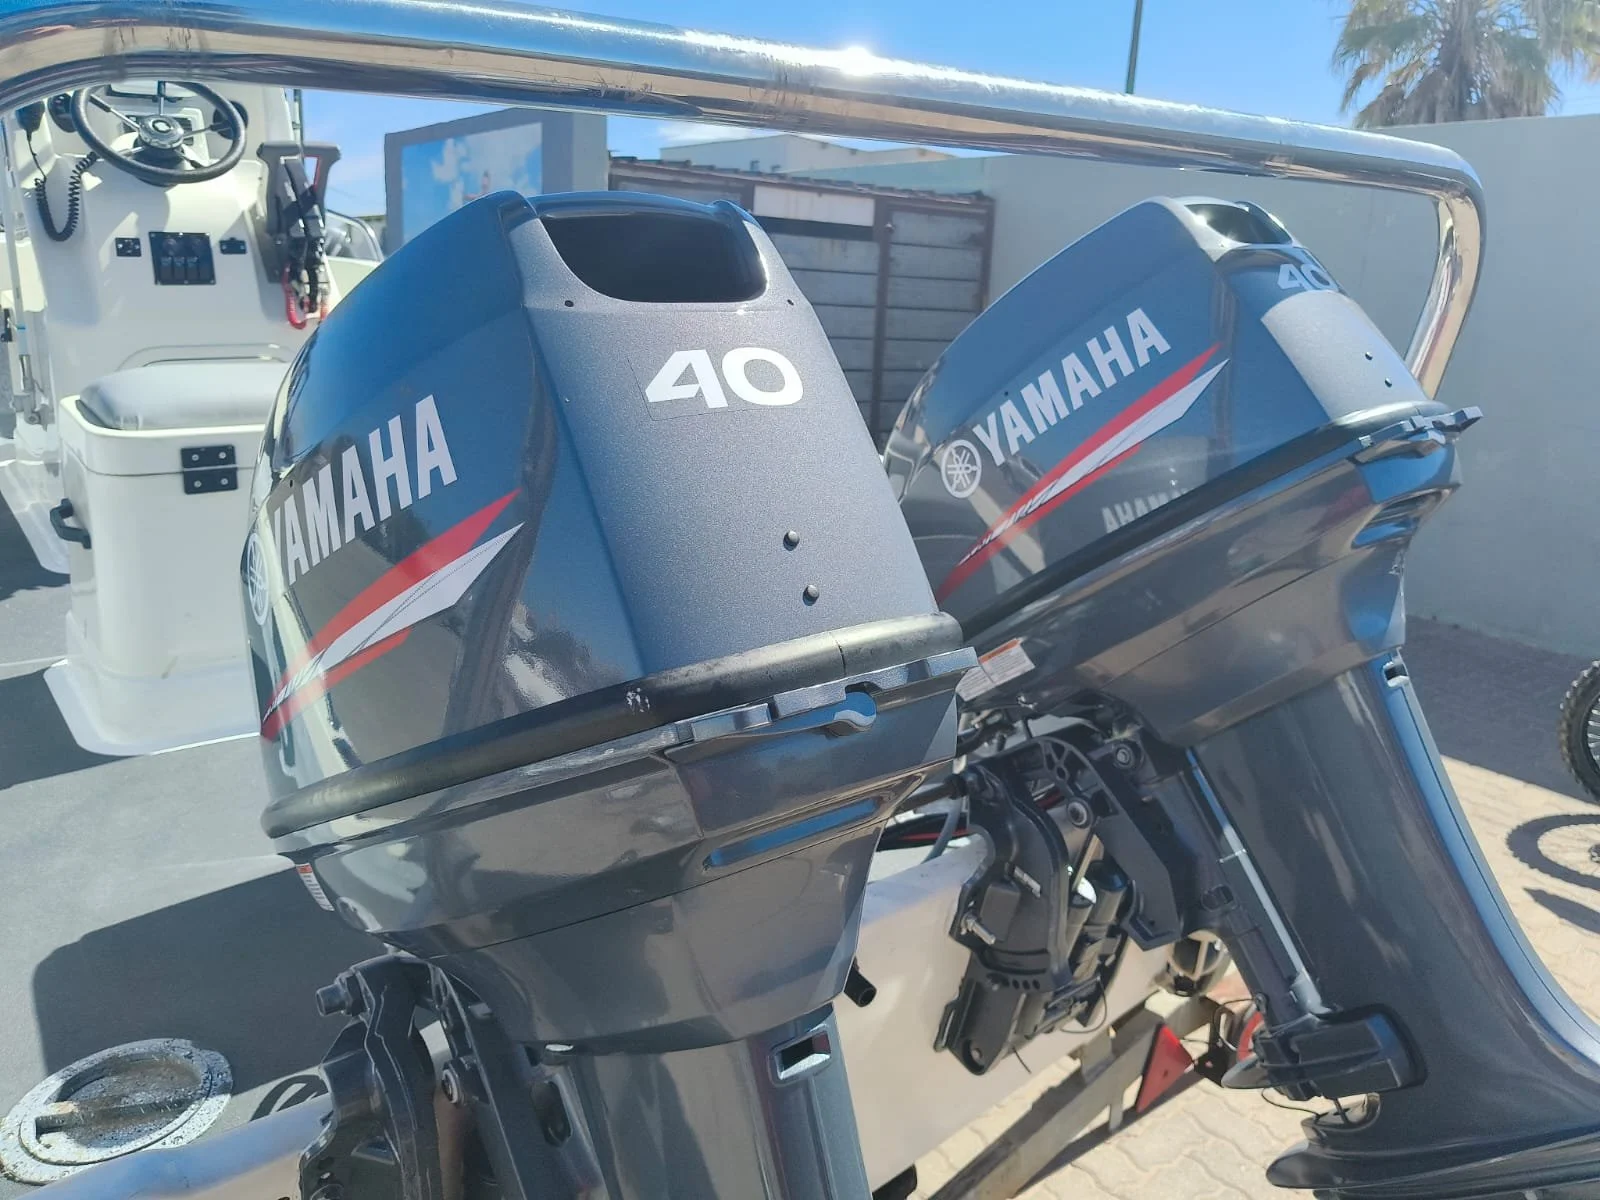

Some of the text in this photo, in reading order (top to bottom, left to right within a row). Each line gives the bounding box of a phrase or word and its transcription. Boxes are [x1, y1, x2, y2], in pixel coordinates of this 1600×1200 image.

[1277, 263, 1339, 292] 40
[645, 347, 804, 409] 40
[972, 307, 1172, 467] YAMAHA
